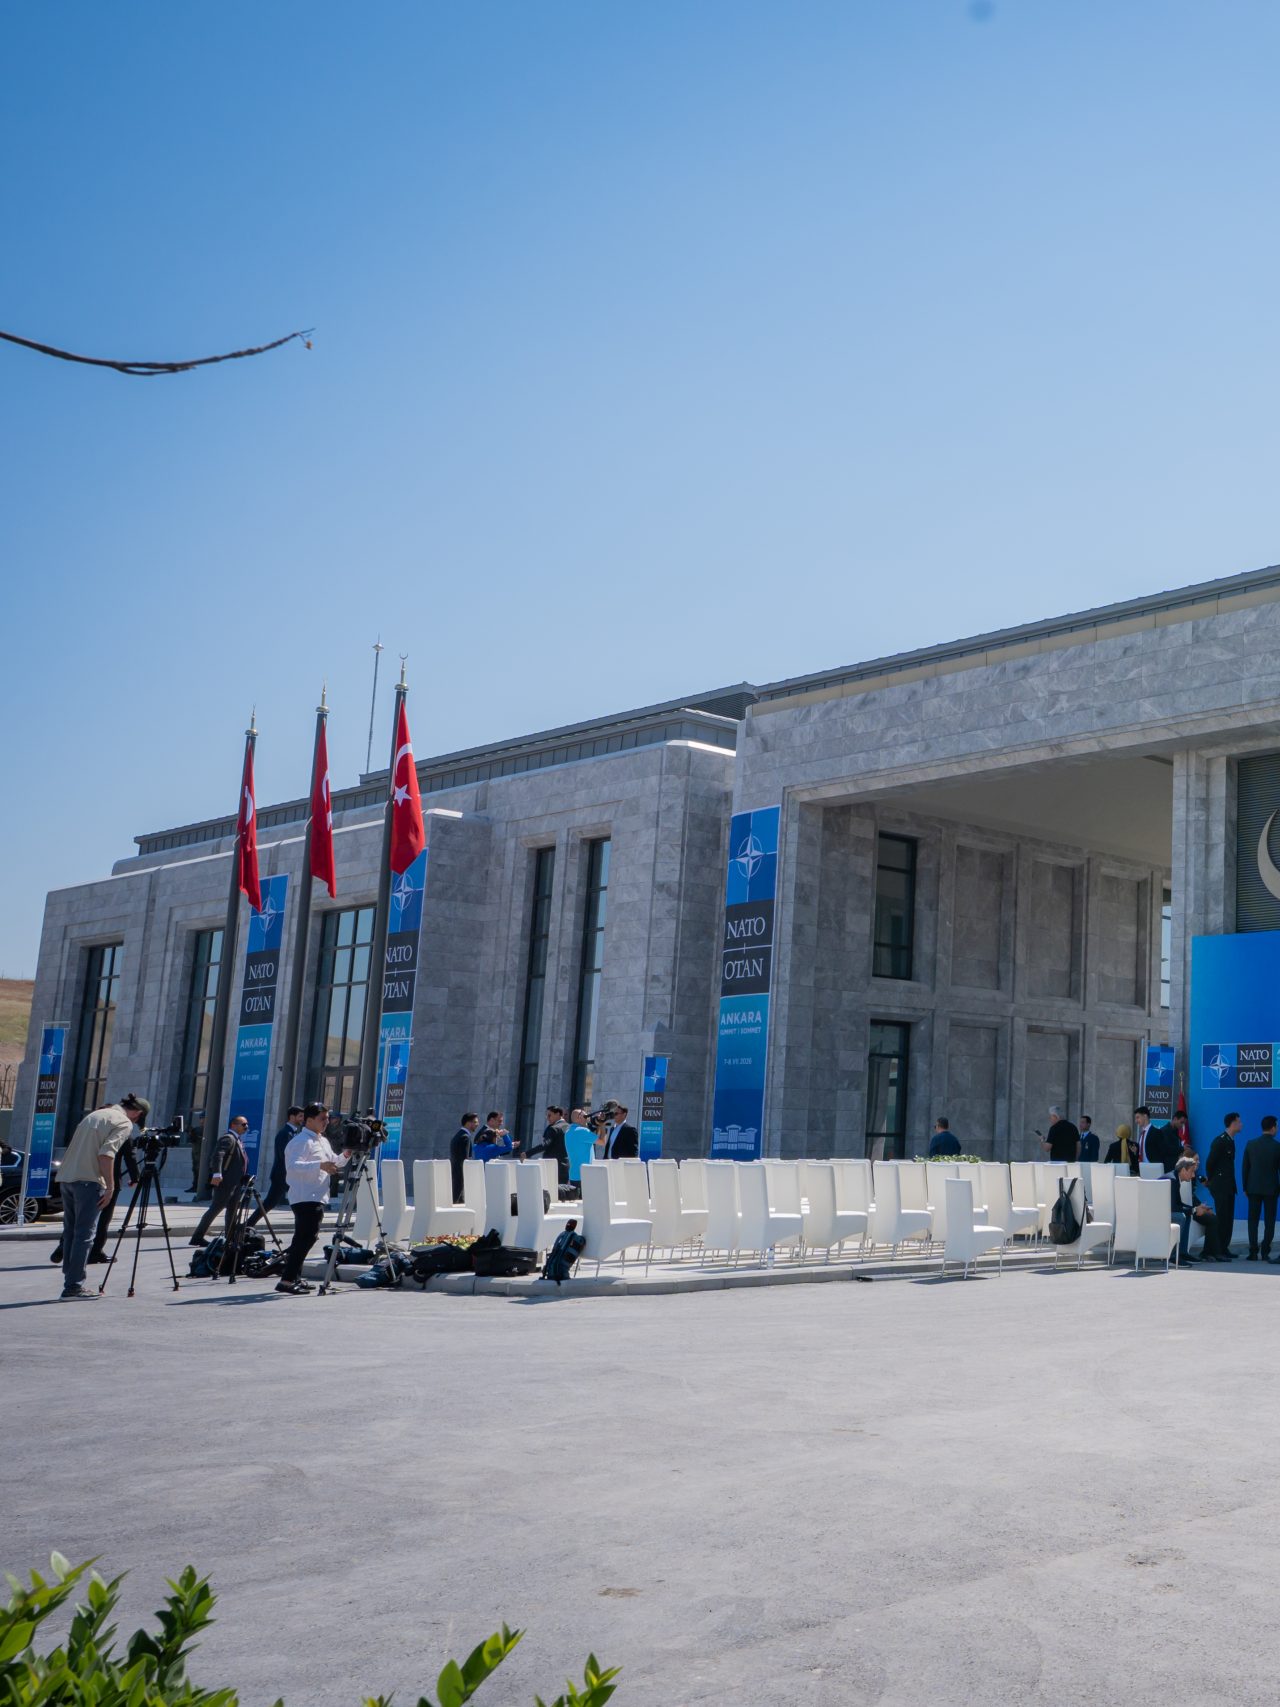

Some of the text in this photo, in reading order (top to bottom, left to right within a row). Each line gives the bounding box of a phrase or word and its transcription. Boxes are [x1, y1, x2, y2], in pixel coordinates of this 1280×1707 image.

[727, 916, 766, 939] NATO
[248, 962, 274, 980] NATO
[724, 958, 764, 980] OTAN
[245, 995, 272, 1012] OTAN
[720, 1010, 762, 1025] ANKARA
[380, 1026, 406, 1038] NKARA
[240, 1037, 268, 1049] ANKARA
[1239, 1049, 1269, 1060] NATO
[1239, 1071, 1269, 1083] OTAN
[1149, 1090, 1169, 1099] NATO
